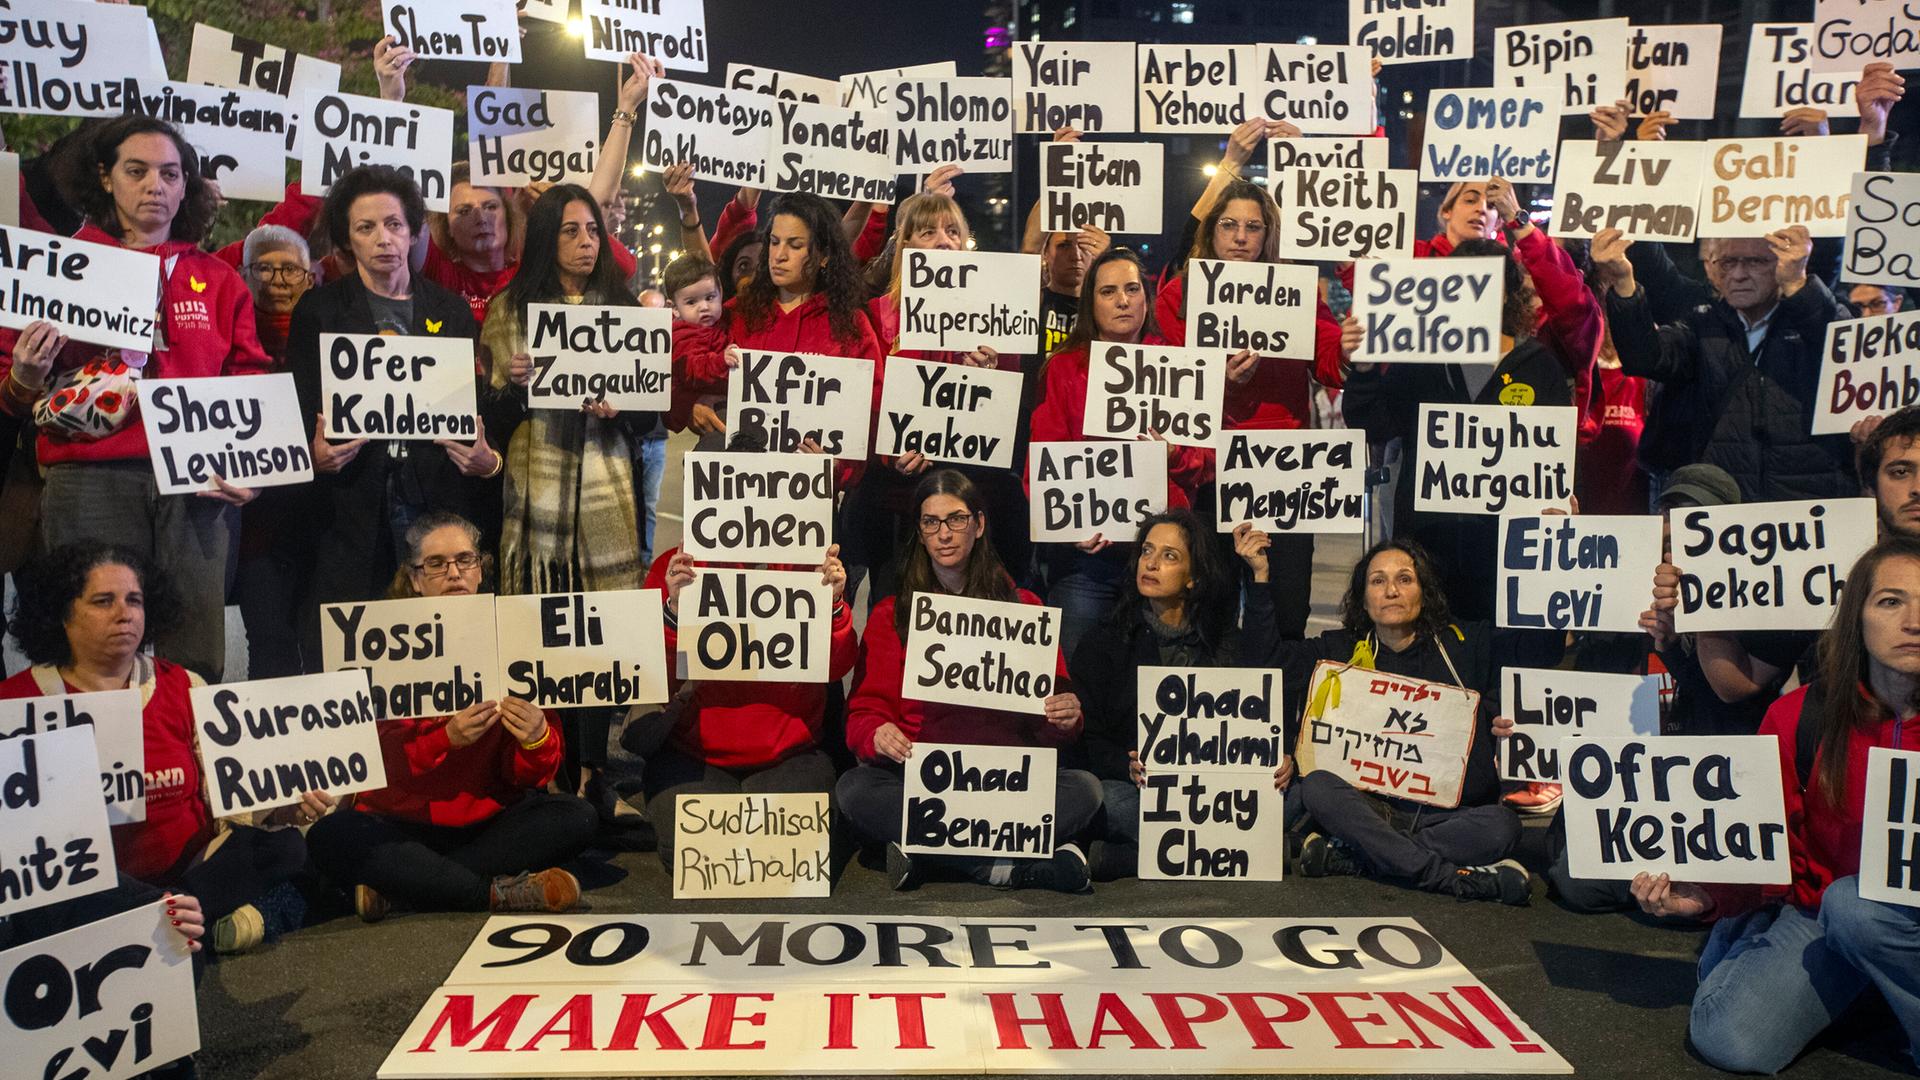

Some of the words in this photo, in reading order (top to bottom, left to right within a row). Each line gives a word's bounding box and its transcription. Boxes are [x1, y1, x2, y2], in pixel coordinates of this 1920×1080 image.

[389, 4, 462, 56] Shem
[460, 13, 508, 57] Tov
[590, 15, 704, 61] Nimrodi
[1357, 16, 1453, 58] Goldin
[1506, 29, 1593, 74] Bipin
[1020, 44, 1090, 87] Yair
[1144, 49, 1236, 87] Arbel
[1266, 48, 1348, 84] Ariel
[122, 77, 284, 134] Avinatan
[314, 95, 420, 150] Omri
[473, 90, 554, 128] Gad
[651, 83, 773, 135] Sontaya
[895, 82, 1009, 123] Shlomo
[1025, 92, 1102, 132] Horn
[1146, 90, 1245, 127] Yehoud
[1264, 89, 1349, 121] Cunio
[1434, 93, 1543, 129] Omer
[479, 135, 594, 183] Haggai
[895, 127, 1011, 165] Mantzur
[1047, 144, 1140, 189] Eitan
[1593, 142, 1671, 186] Ziv
[1714, 141, 1799, 181] Gali
[1047, 191, 1124, 232] Horn
[1296, 170, 1398, 209] Keith
[1296, 212, 1404, 256] Siegel
[1560, 192, 1694, 238] Berman
[908, 251, 978, 289] Bar
[1199, 261, 1300, 307] Yarden
[1367, 263, 1493, 315] Segev
[533, 310, 670, 354] Matan
[906, 297, 1039, 347] Kupershtein
[1197, 312, 1289, 353] Bibas
[1366, 312, 1489, 355] Kalfon
[531, 356, 671, 400] Zangauker
[742, 352, 841, 405] Kfir
[916, 364, 991, 412] Yair
[1104, 346, 1206, 401] Shiri
[151, 385, 261, 440] Shay
[332, 394, 475, 435] Kalderon
[1106, 397, 1211, 440] Bibas
[888, 411, 1000, 461] Yaakov
[1224, 434, 1352, 472] Avera
[1426, 410, 1560, 467] Eliyhu
[161, 443, 310, 486] Levinson
[692, 459, 832, 501] Nimrod
[1037, 444, 1133, 482] Ariel
[1421, 460, 1571, 512] Margalit
[1044, 488, 1154, 530] Bibas
[1220, 476, 1363, 531] Mengistu
[691, 505, 825, 549] Cohen
[1503, 517, 1619, 572] Eitan
[1683, 505, 1826, 566] Sagui
[698, 573, 815, 619] Alon
[1506, 576, 1603, 629] Levi
[1680, 565, 1784, 615] Dekel
[327, 605, 444, 662] Yossi
[540, 595, 603, 648] Eli
[915, 595, 1052, 647] Bannawat
[697, 621, 809, 670] Ohel
[336, 666, 482, 719] harabi
[508, 660, 641, 705] Sharabi
[917, 643, 1052, 699] Seathao
[1370, 679, 1441, 702] ילדים
[204, 689, 375, 746] Surasak
[1156, 674, 1272, 722] Ohad
[1383, 707, 1428, 734] לא
[1514, 673, 1597, 727] Lior
[1140, 712, 1281, 767] Yahalomi
[1311, 720, 1423, 764] מחזיקים
[214, 751, 367, 811] Rumnao
[920, 749, 1031, 794] Ohad
[1350, 758, 1437, 796] בשבי
[1568, 743, 1741, 802] Ofra
[680, 797, 830, 836] Sudthisak
[1143, 774, 1258, 830] Itay
[1157, 829, 1249, 877] Chen
[1596, 807, 1784, 865] Keidar
[680, 847, 830, 890] Rinthalak
[480, 922, 649, 968] 90
[680, 921, 1051, 969] MORE
[1073, 924, 1244, 970] TO
[1272, 924, 1443, 970] GO
[6, 944, 152, 1030] Or
[408, 993, 775, 1053] MAKE
[823, 993, 946, 1050] IT
[982, 986, 1546, 1052] HAPPEN!
